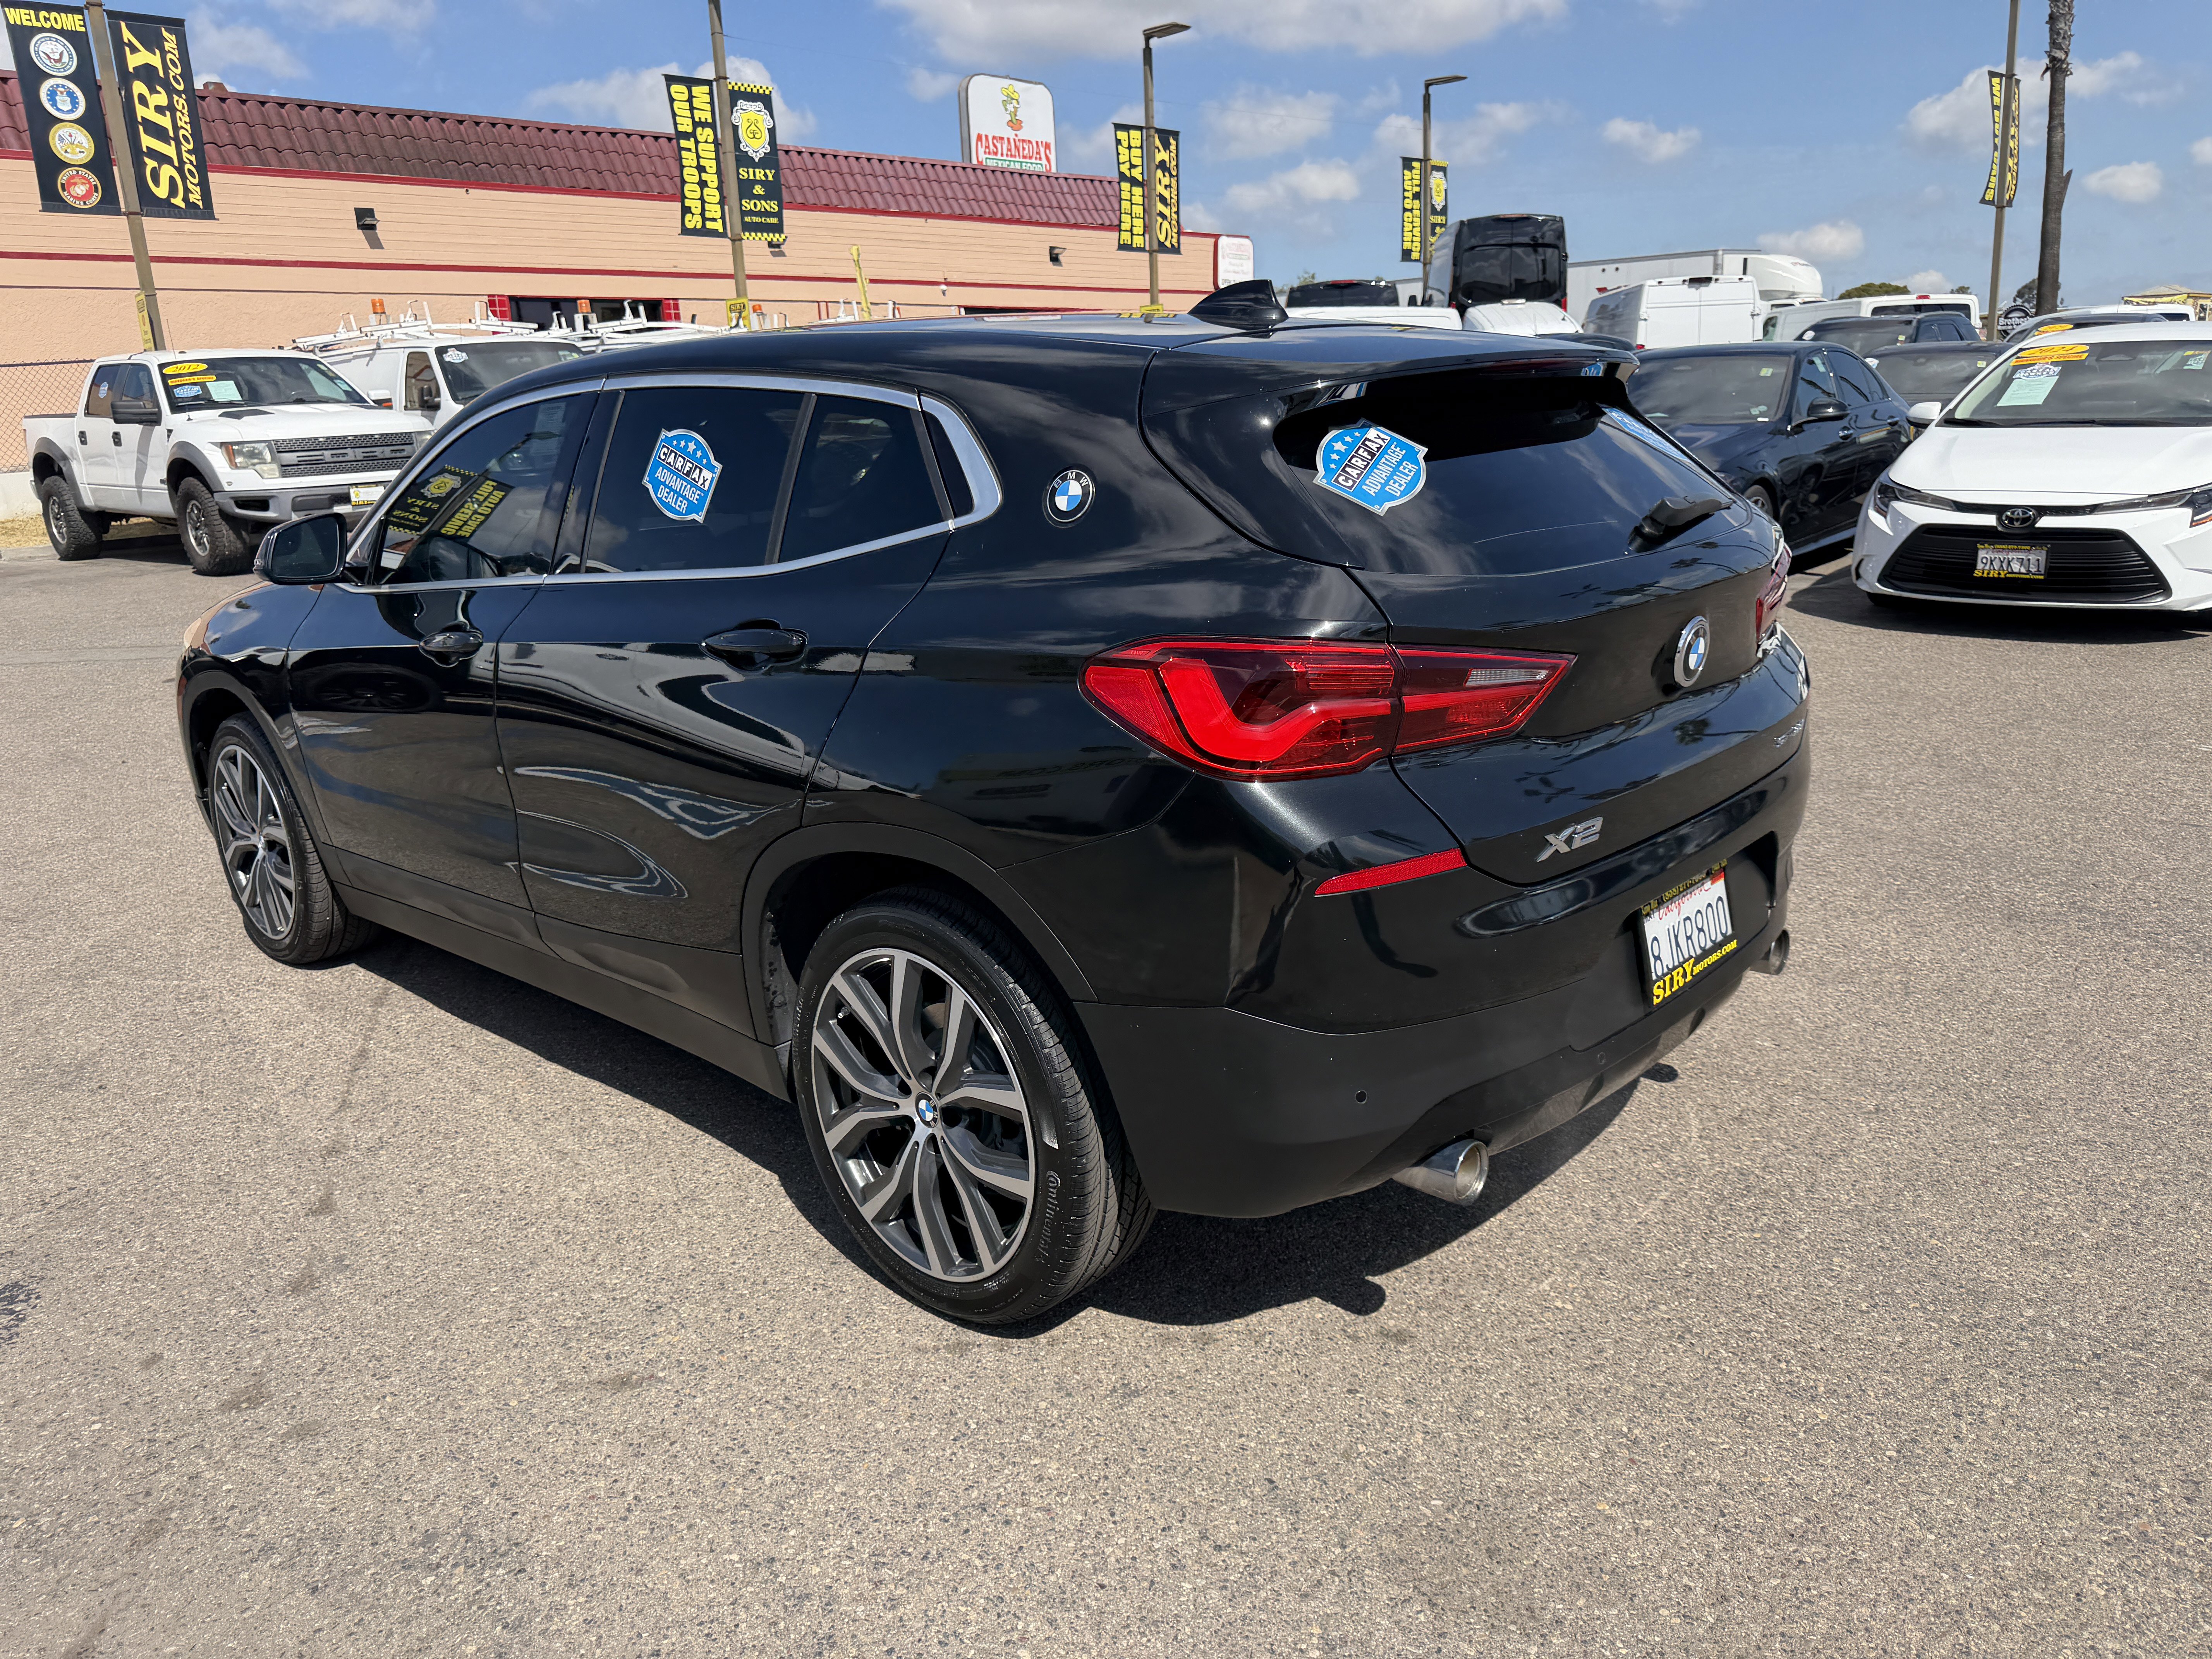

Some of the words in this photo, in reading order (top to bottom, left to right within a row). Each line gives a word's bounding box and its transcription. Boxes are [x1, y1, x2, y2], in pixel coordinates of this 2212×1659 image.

[5, 8, 86, 32] WELCOME
[670, 84, 693, 132] OUR
[691, 86, 712, 123] WE
[1991, 77, 2001, 106] WE
[120, 21, 186, 209] SIRY
[161, 27, 203, 209] MOTORS.COM
[738, 168, 775, 181] SIRY
[1116, 131, 1131, 178] PAY
[1129, 130, 1143, 182] BUY
[679, 137, 702, 229] TROOPS
[696, 127, 724, 233] SUPPORT
[752, 185, 765, 195] &
[1154, 133, 1171, 248] SIRY
[1403, 170, 1413, 209] AUTO
[1412, 161, 1421, 194] FULL
[741, 199, 779, 213] SONS
[1120, 182, 1132, 245] HERE
[1131, 187, 1144, 248] HERE
[1403, 211, 1413, 250] CARE
[1411, 199, 1421, 260] SERVICE
[171, 364, 200, 373] 2012
[659, 447, 709, 489] CARFAX
[1053, 471, 1089, 489] BMW
[1338, 433, 1389, 486] CARFAX
[1361, 444, 1407, 496] ADVANTAGE
[1385, 460, 1419, 497] DEALER
[655, 466, 700, 504] ADVANTAGE
[657, 484, 688, 514] DEALER
[1973, 570, 2008, 578] SIRY
[1980, 556, 2042, 573] 9KXK711
[1536, 816, 1604, 862] X2
[1650, 895, 1729, 979] 8JKR800
[1653, 957, 1695, 1006] SIRY
